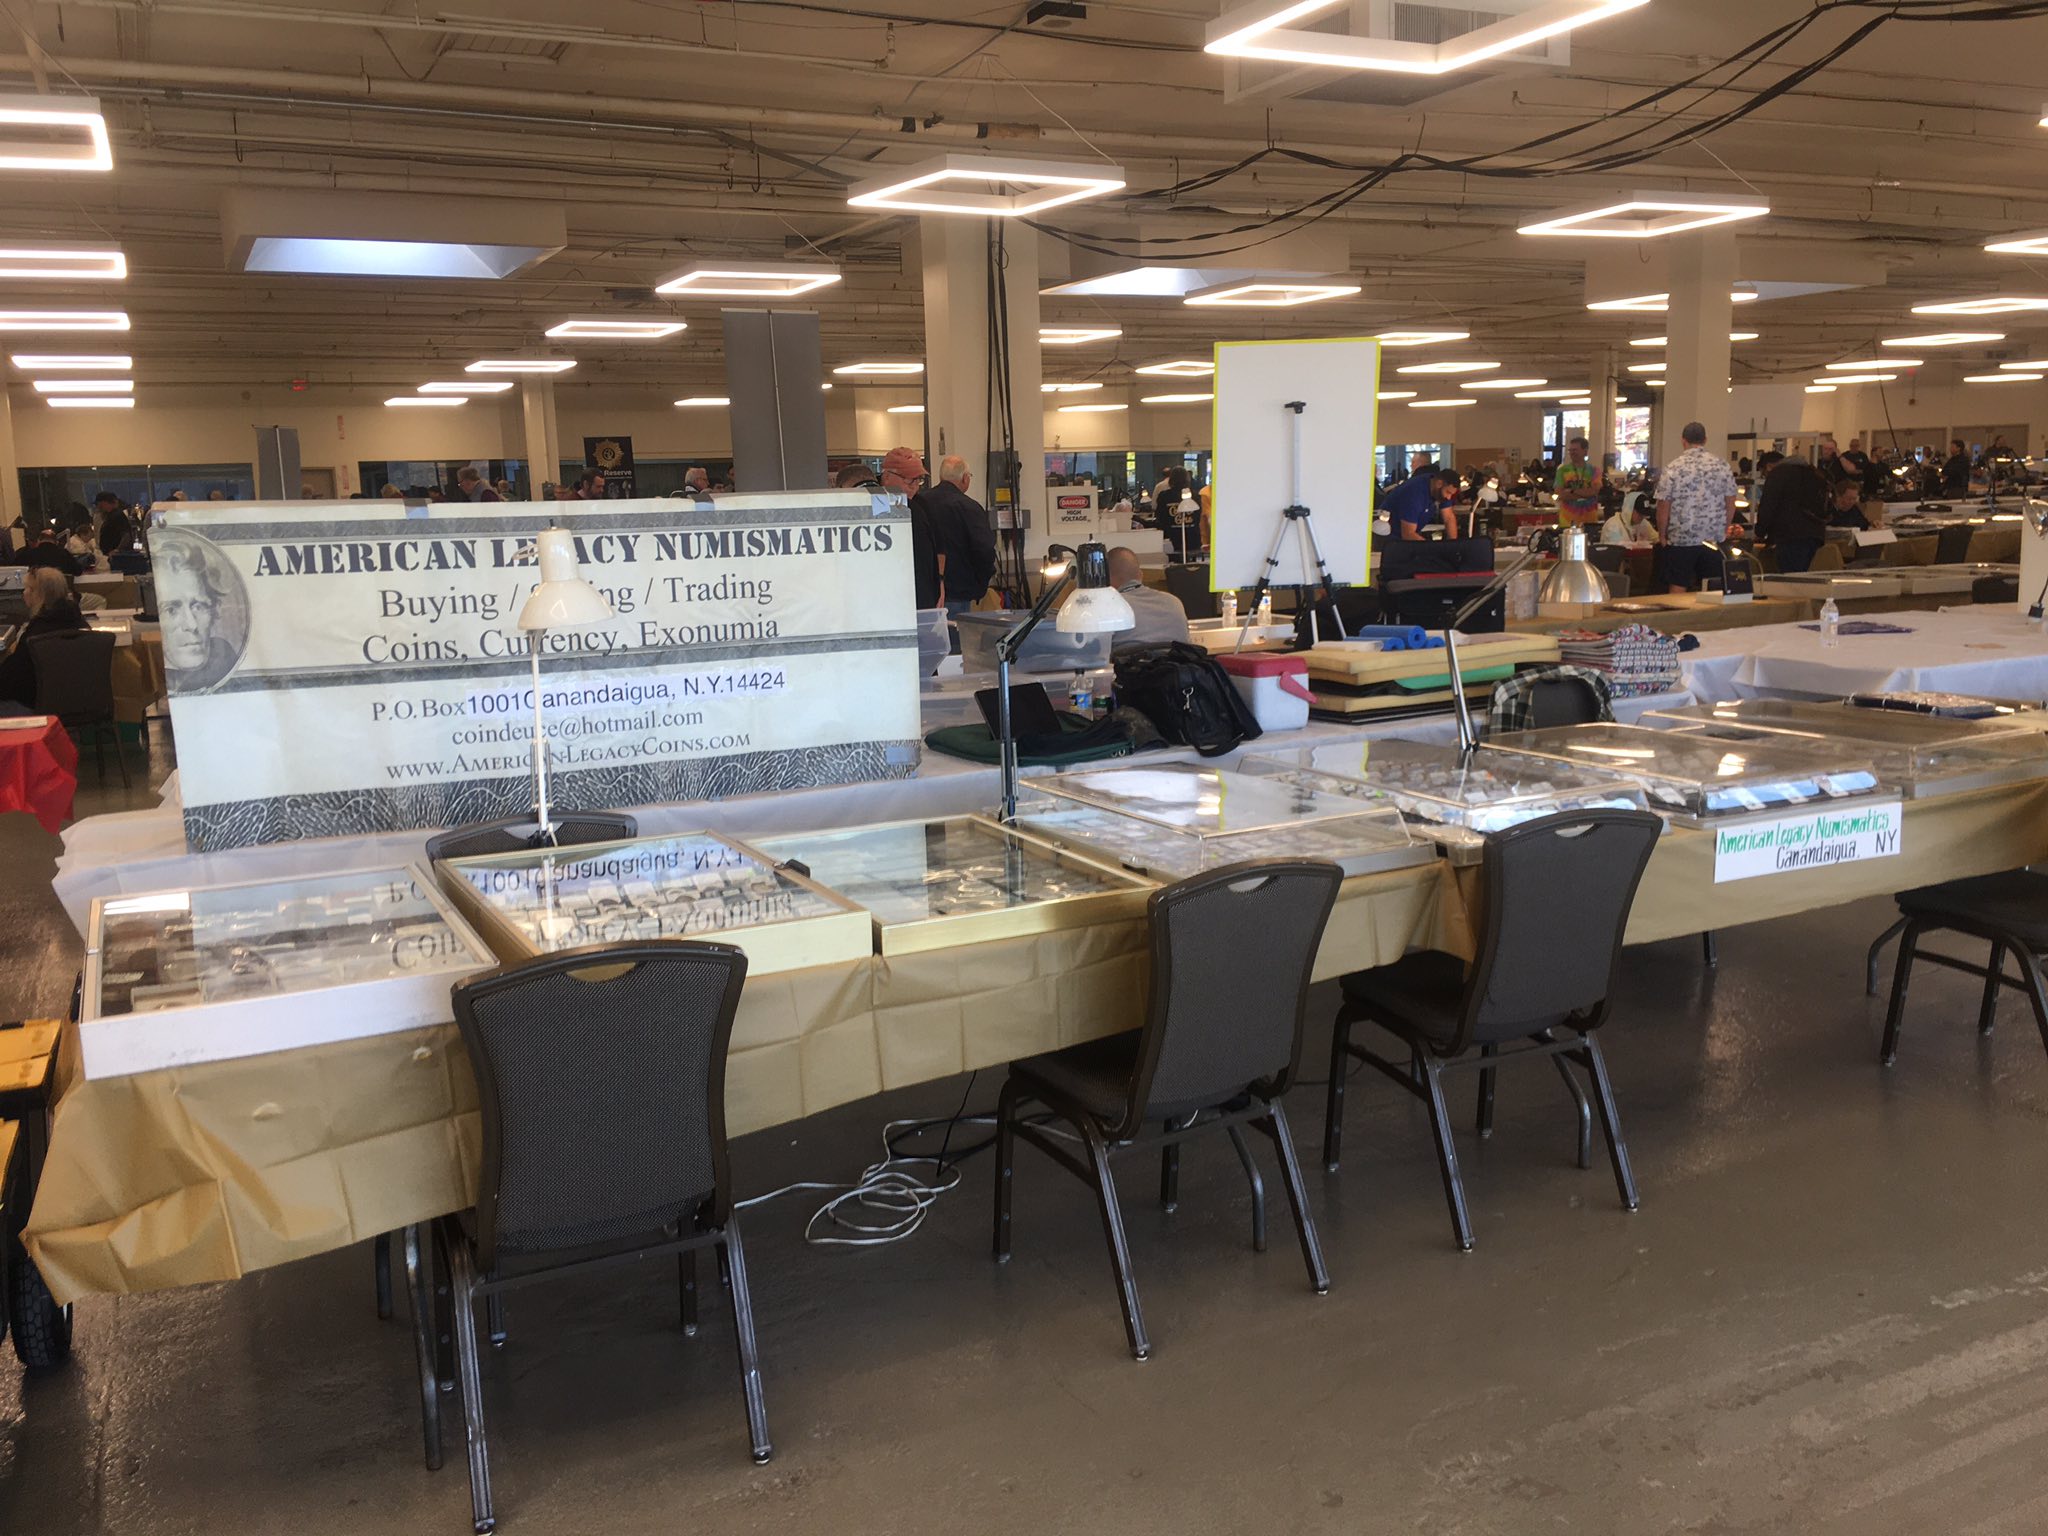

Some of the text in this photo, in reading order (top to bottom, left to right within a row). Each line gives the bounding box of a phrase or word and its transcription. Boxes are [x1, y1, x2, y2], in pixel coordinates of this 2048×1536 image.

[254, 524, 893, 577] AMERICAN LEACY NUMISMATICS
[379, 586, 499, 623] Buying
[663, 574, 773, 605] Trading
[363, 633, 469, 663] Coins,
[639, 613, 780, 647] Exonumia
[1718, 829, 1774, 855] American
[1815, 809, 1889, 840] Numismatics
[1875, 828, 1898, 854] NY
